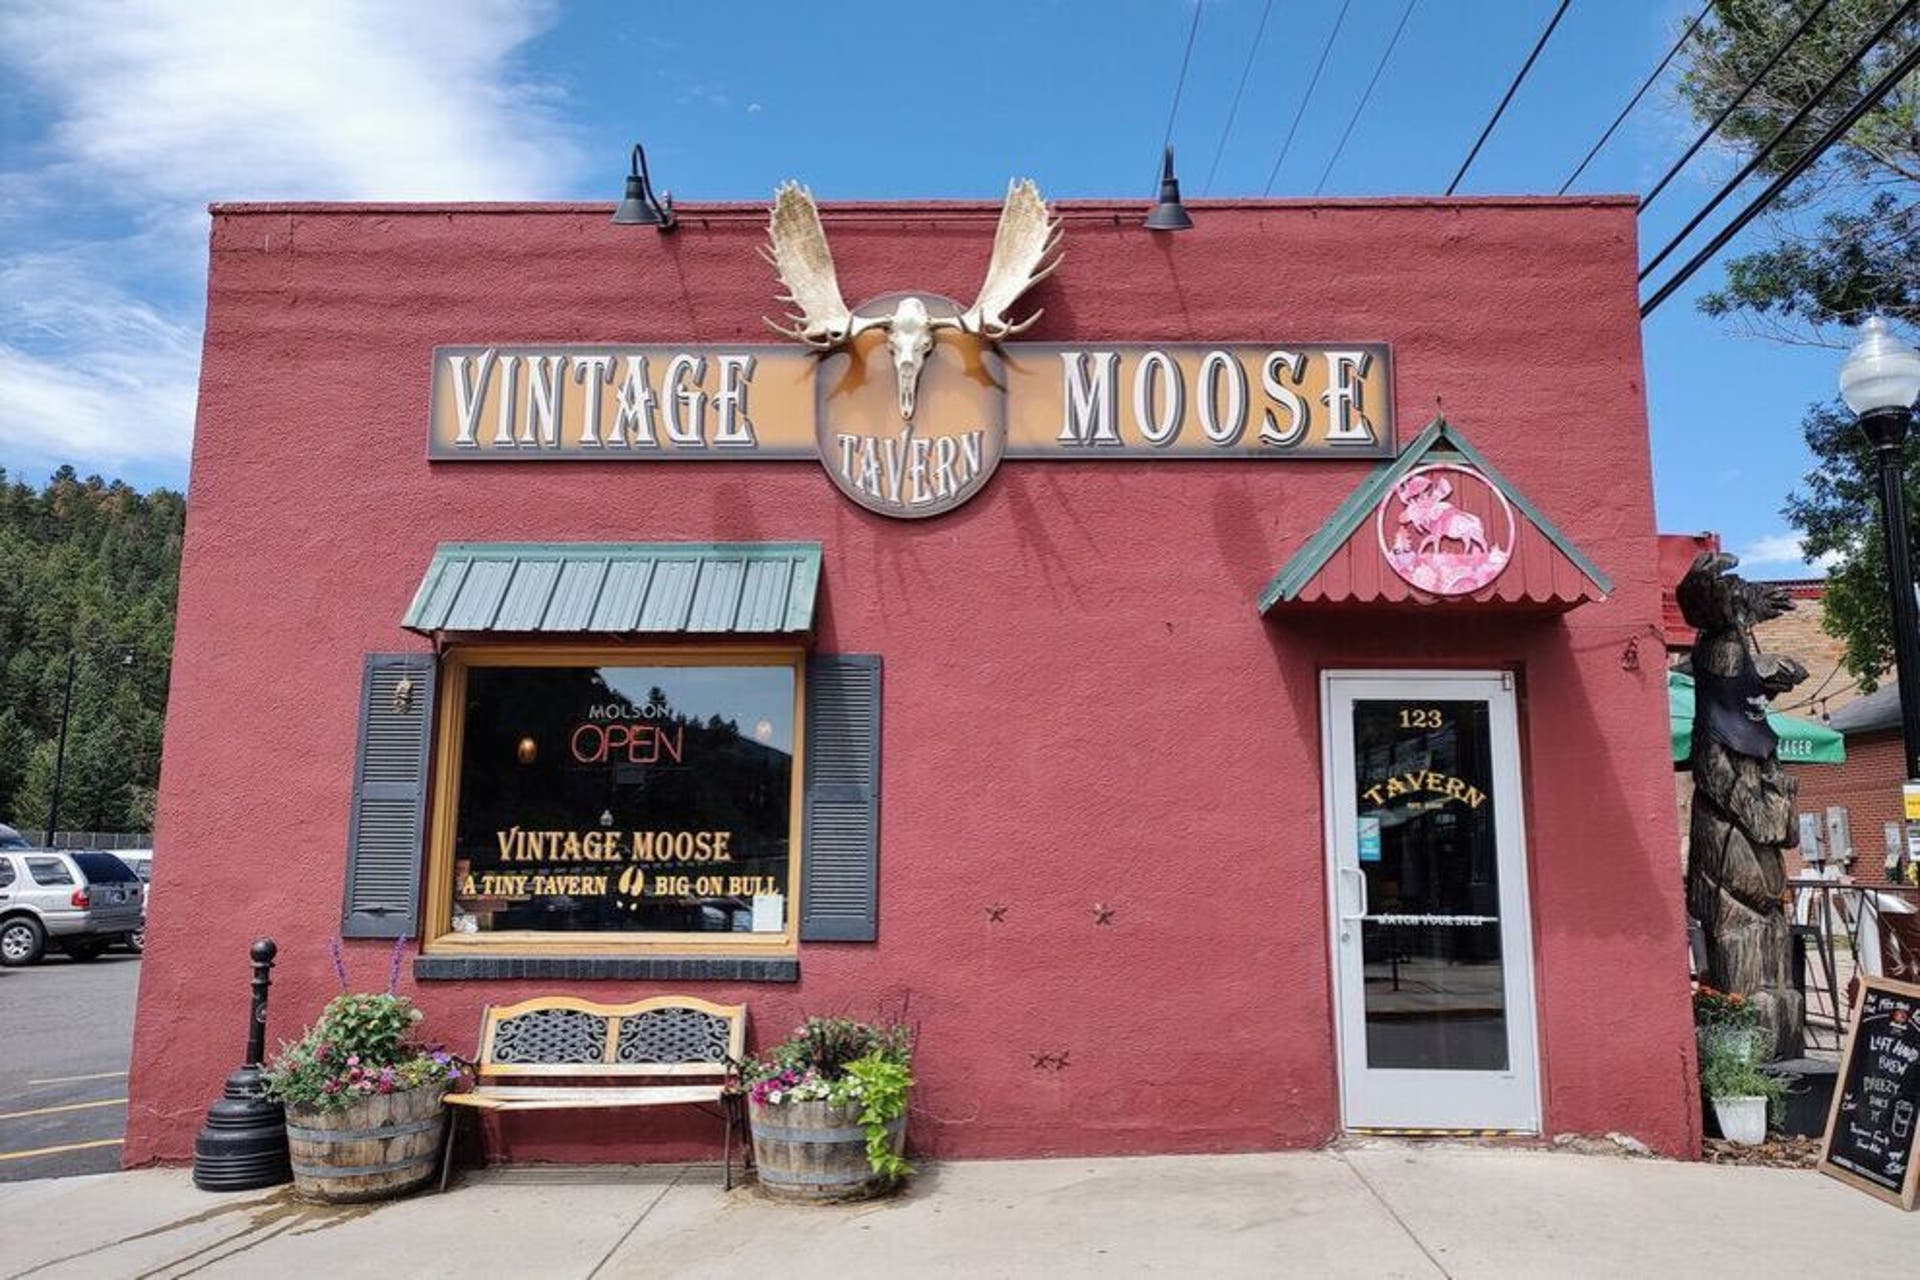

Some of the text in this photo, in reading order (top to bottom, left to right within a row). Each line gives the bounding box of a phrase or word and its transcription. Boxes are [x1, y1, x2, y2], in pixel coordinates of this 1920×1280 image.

[449, 348, 1379, 448] VINTAGE MOOSE
[837, 423, 985, 502] TAVERN
[589, 704, 669, 718] MOLSON
[1400, 709, 1443, 728] 123
[571, 724, 683, 763] OPEN
[1362, 770, 1487, 809] TAVERN
[497, 826, 731, 861] VINTAGE MOOSE
[461, 875, 779, 896] A TINY TAVERN BIG ON BULL
